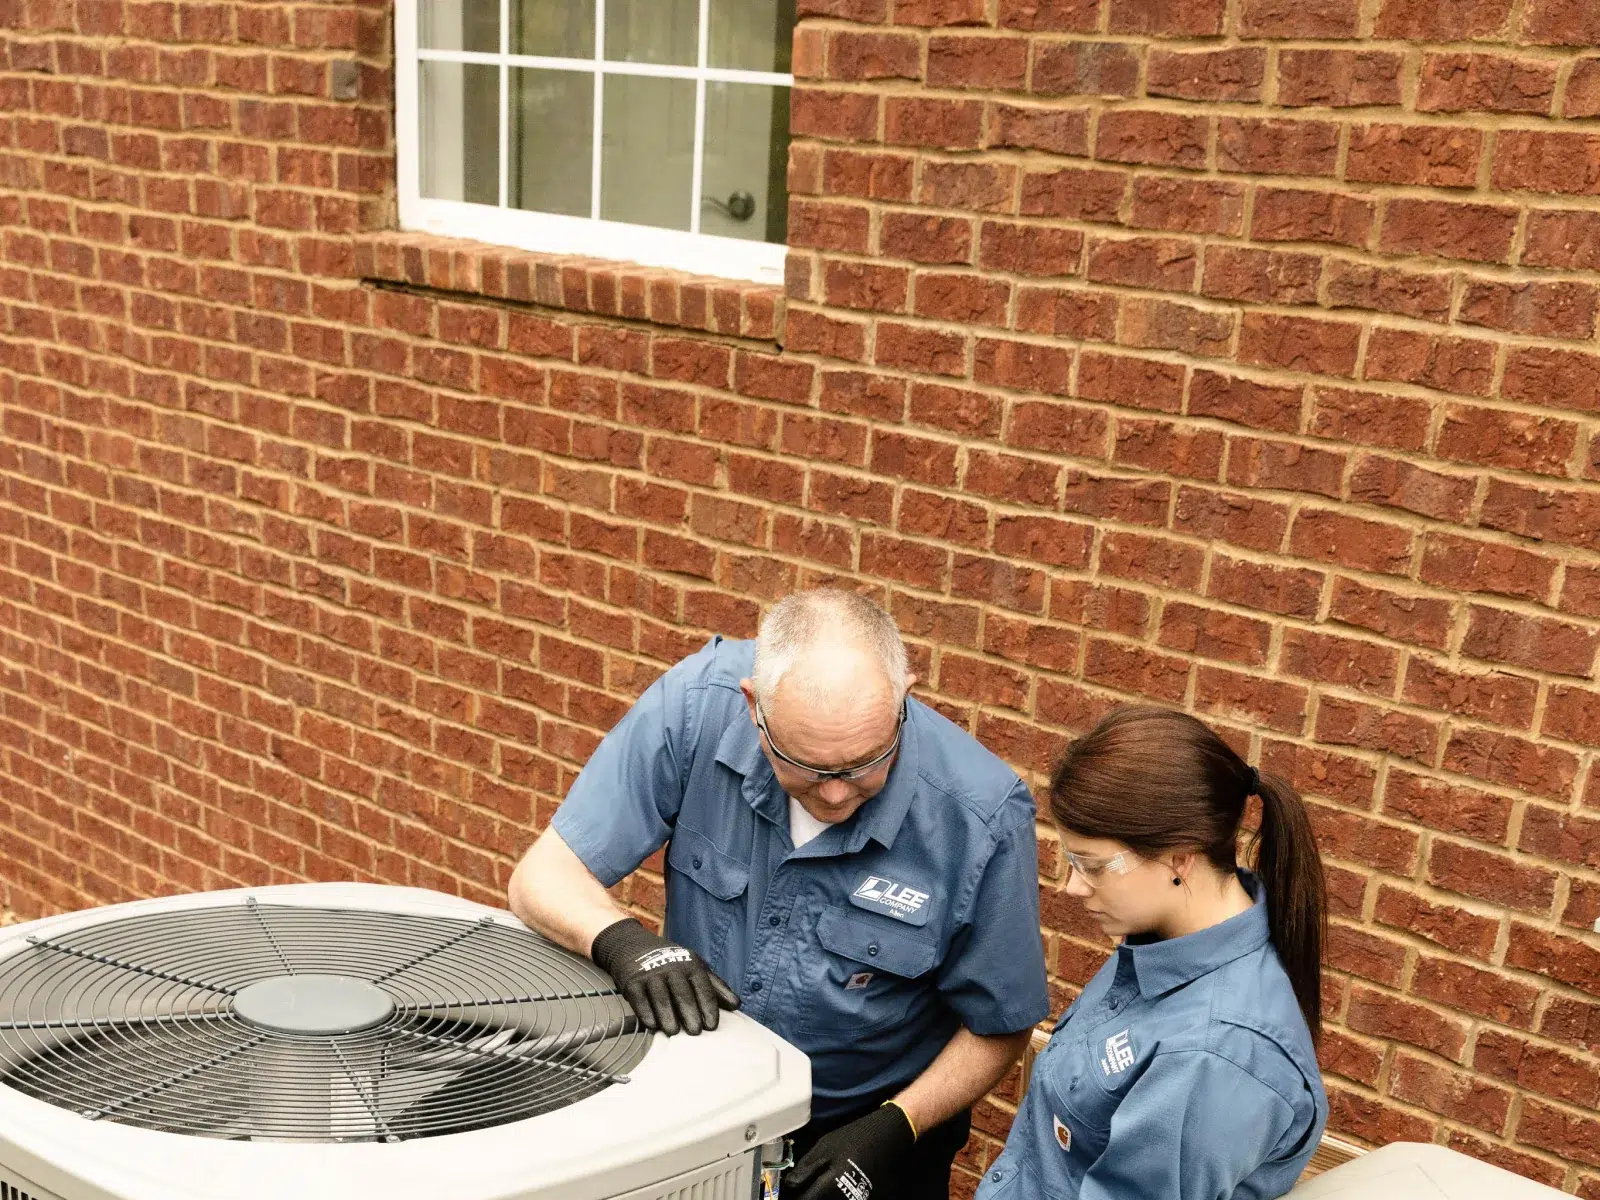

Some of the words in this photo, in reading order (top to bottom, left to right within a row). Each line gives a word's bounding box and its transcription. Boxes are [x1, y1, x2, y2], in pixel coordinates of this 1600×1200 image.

[880, 897, 917, 914] COMPANY
[883, 883, 930, 909] LEE
[1113, 1038, 1135, 1073] LEE
